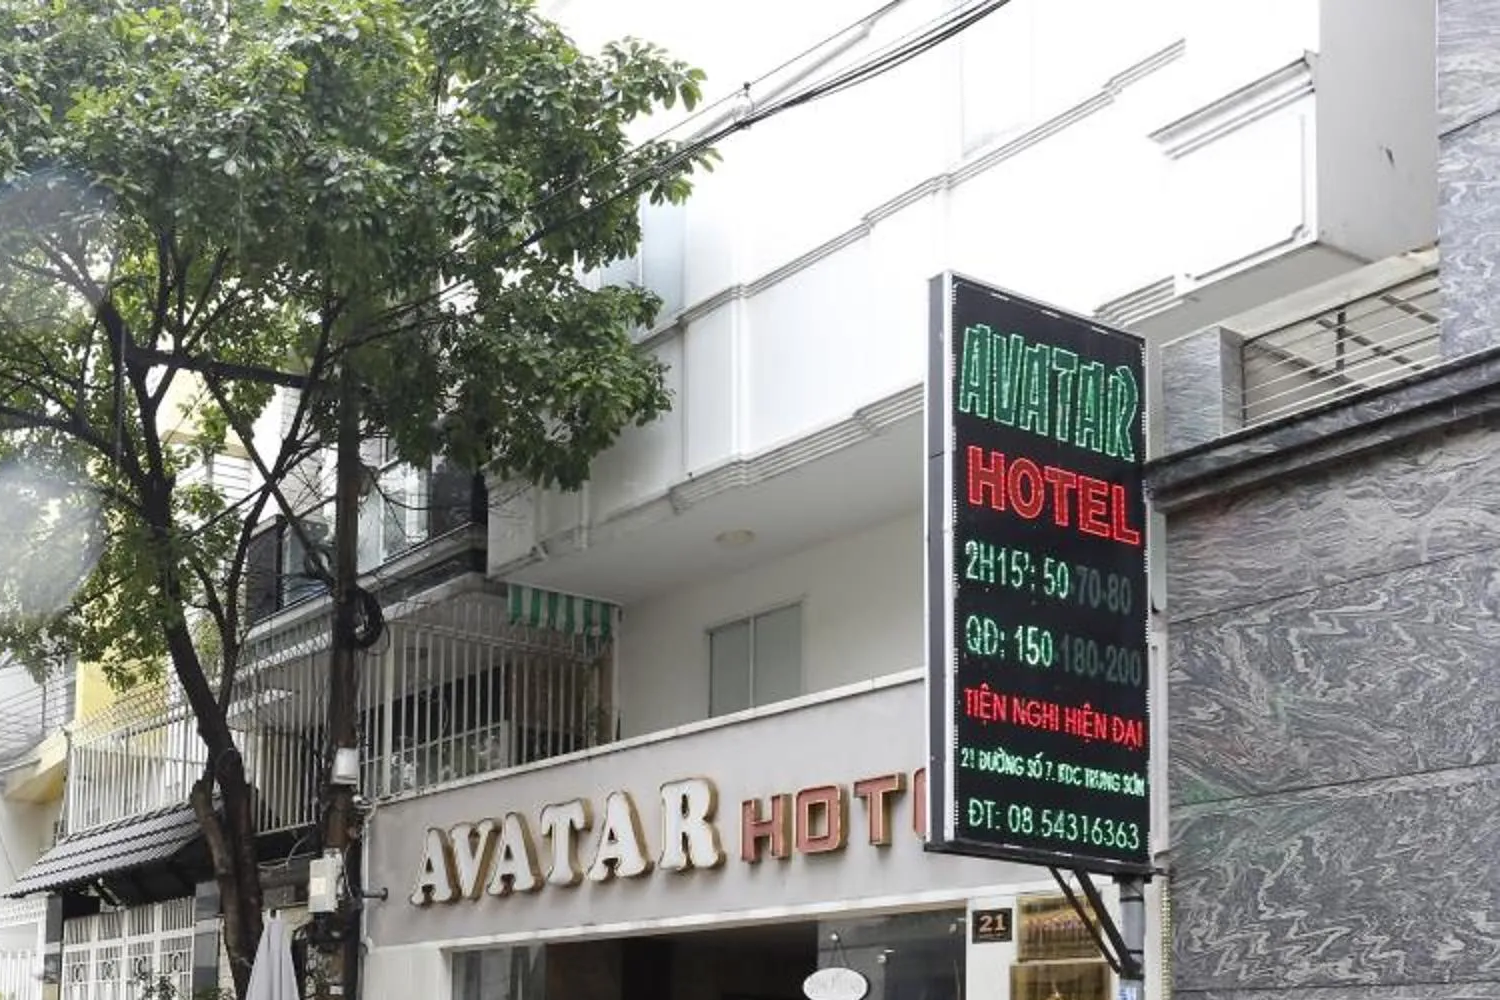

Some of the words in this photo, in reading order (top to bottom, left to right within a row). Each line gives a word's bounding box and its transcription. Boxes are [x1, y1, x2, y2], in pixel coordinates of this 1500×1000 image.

[959, 323, 1138, 463] AVATAR
[967, 445, 1140, 545] HOTEL
[964, 683, 1007, 728] TIỆN
[1012, 697, 1060, 732] NGHI
[1065, 703, 1107, 743] HIỆN
[1111, 716, 1143, 751] ĐẠI
[410, 778, 725, 906] AVATAR
[741, 767, 926, 864] HOT
[979, 913, 1007, 933] 21
